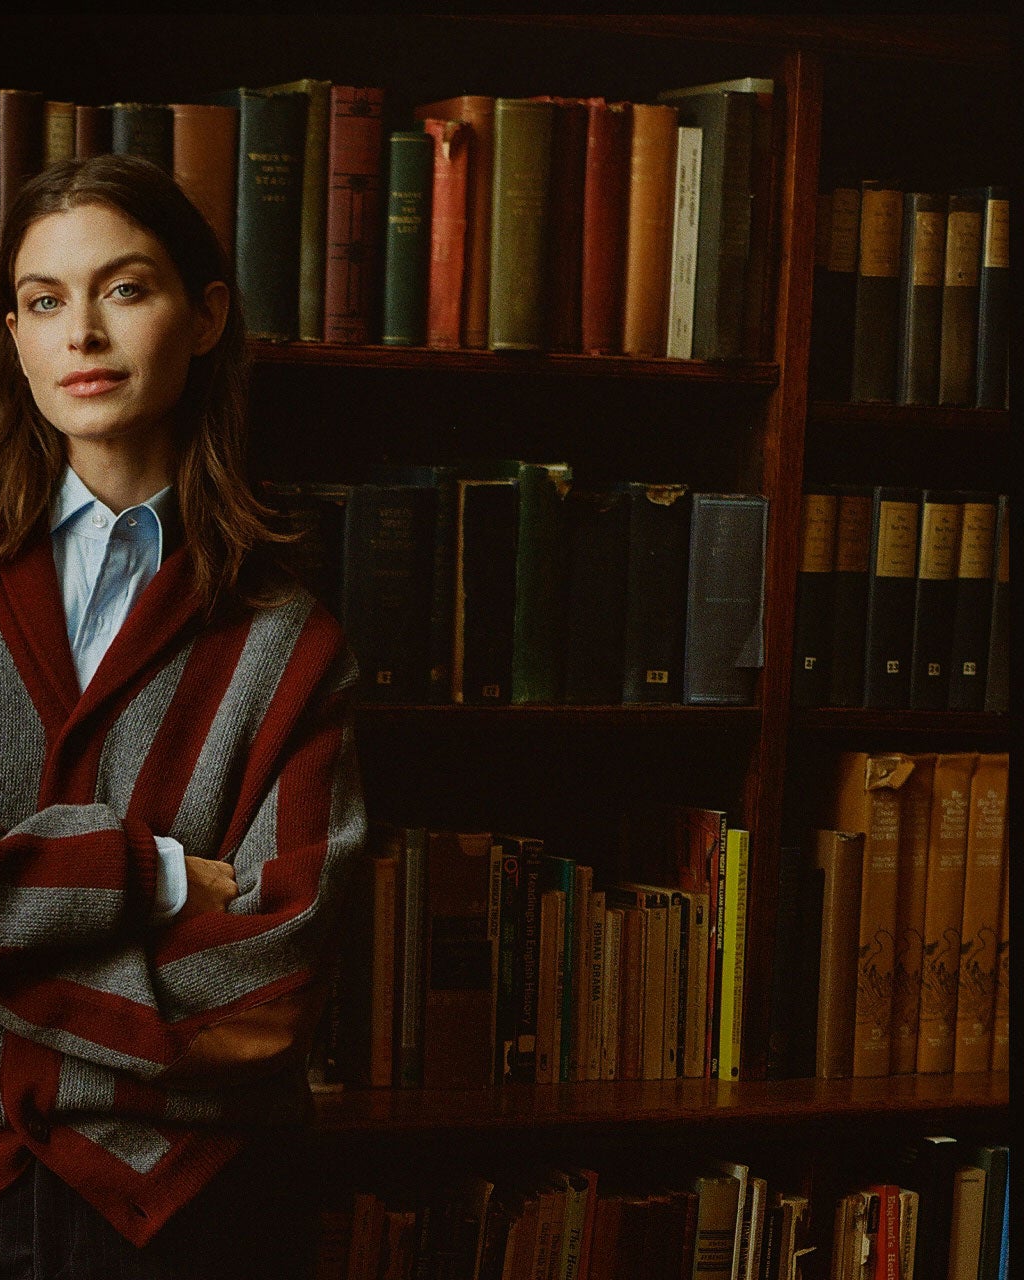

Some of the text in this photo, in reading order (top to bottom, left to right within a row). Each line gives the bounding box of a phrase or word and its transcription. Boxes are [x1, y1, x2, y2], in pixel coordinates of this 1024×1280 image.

[720, 818, 728, 851] TWELFTH
[522, 871, 538, 1025] Readings in English History
[592, 922, 603, 1001] ROMAN DRAMA
[569, 1229, 580, 1251] The
[886, 1195, 896, 1249] England's
